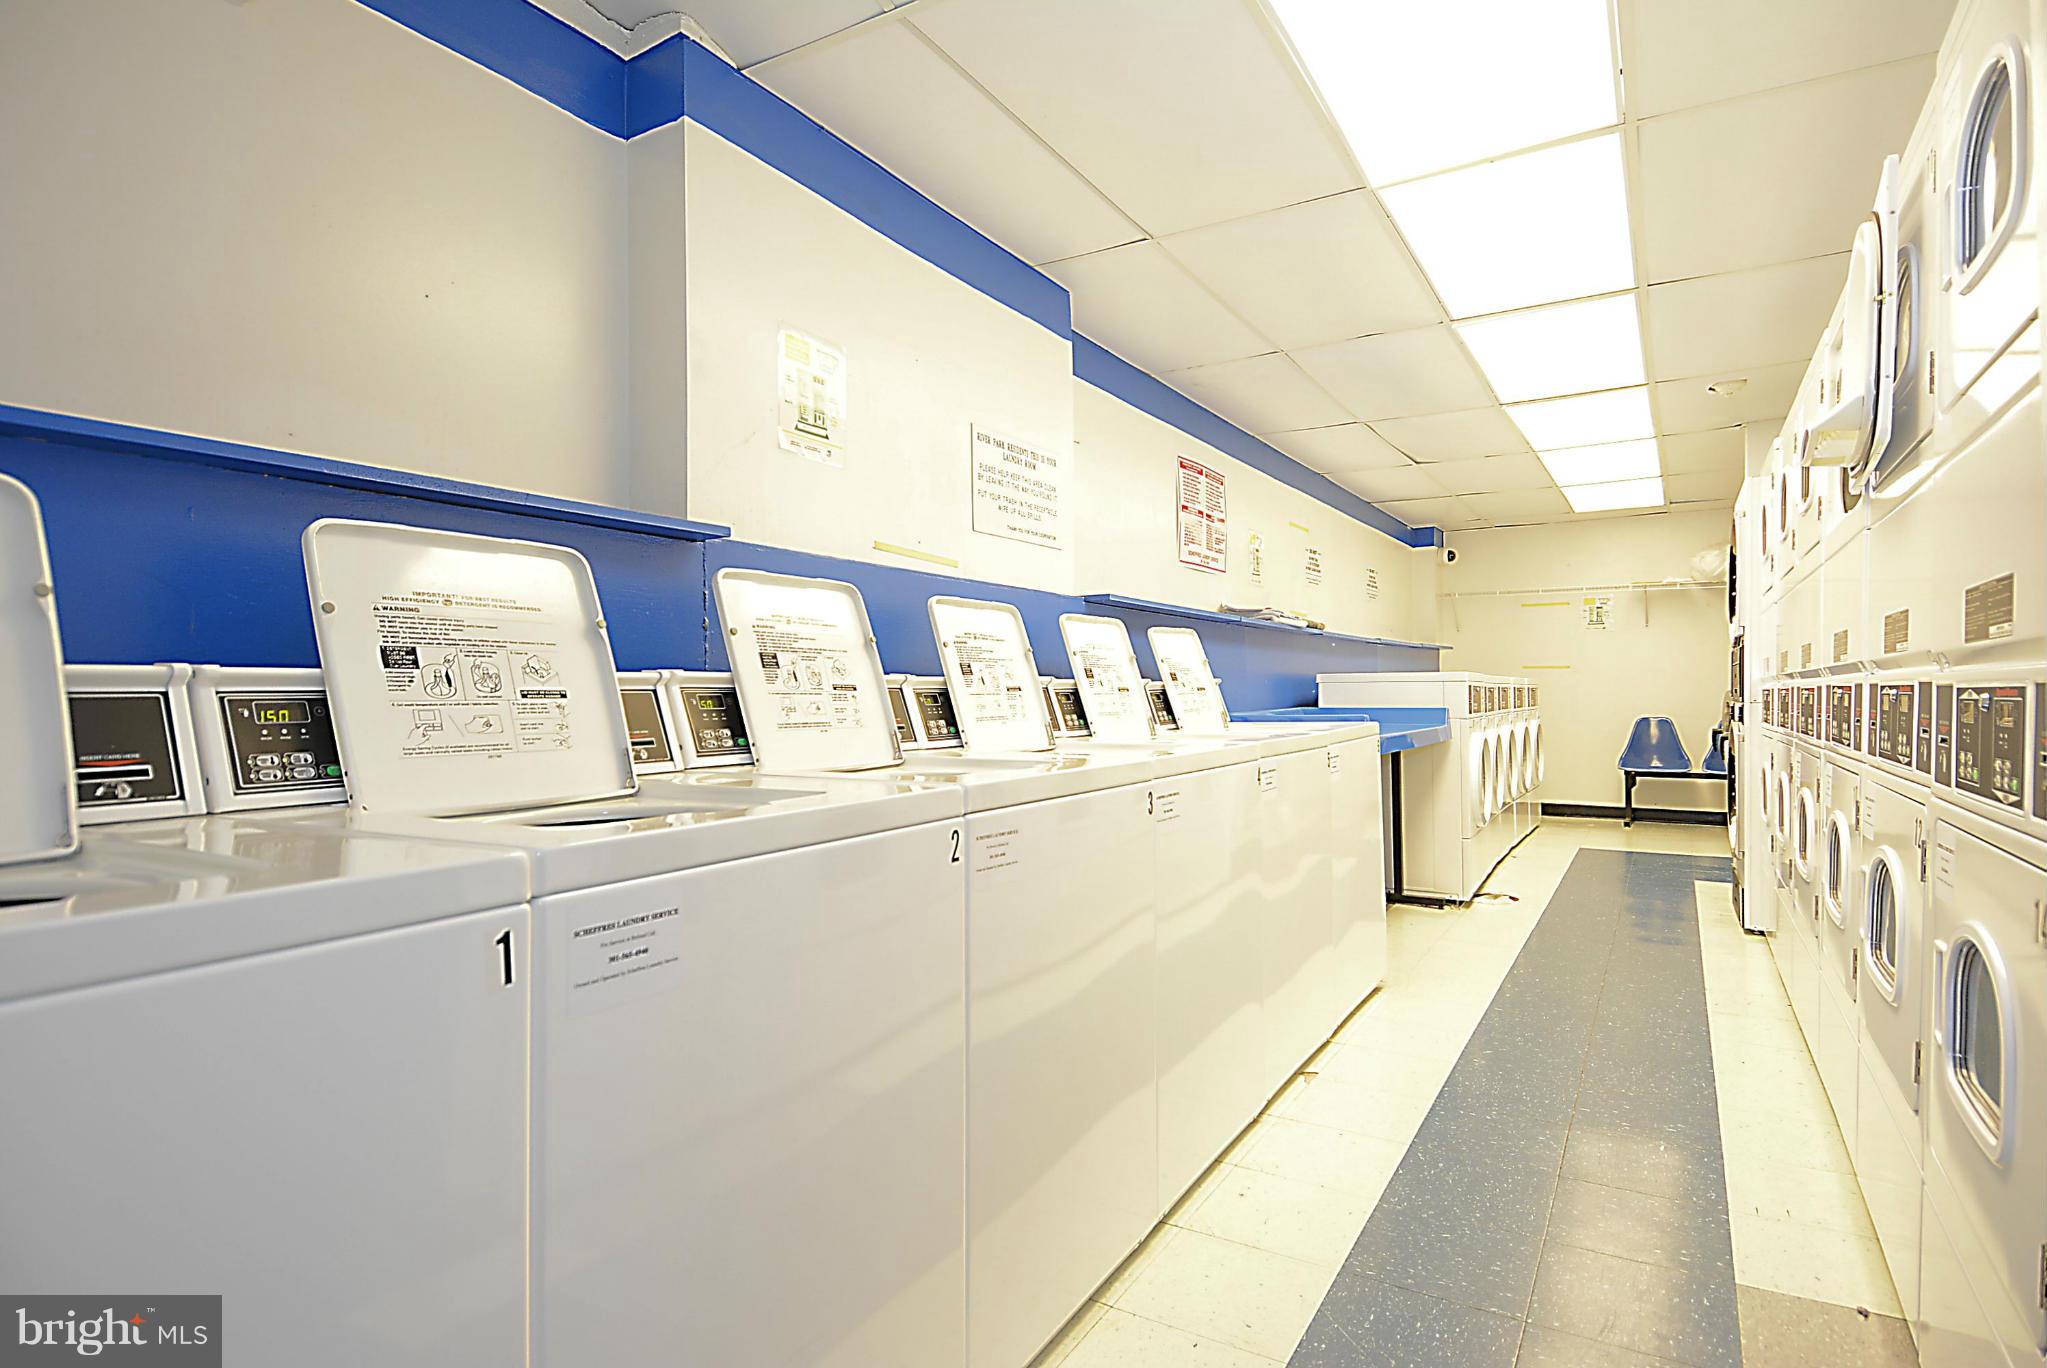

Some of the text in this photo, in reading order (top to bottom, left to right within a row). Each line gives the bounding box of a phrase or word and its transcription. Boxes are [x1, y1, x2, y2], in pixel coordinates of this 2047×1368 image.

[381, 605, 420, 613] WARNING
[261, 710, 288, 723] 150
[1148, 792, 1153, 815] 3
[951, 830, 960, 863] 2
[616, 914, 650, 929] LAUNDRY
[650, 908, 679, 920] SERVICE
[496, 930, 512, 985] 1
